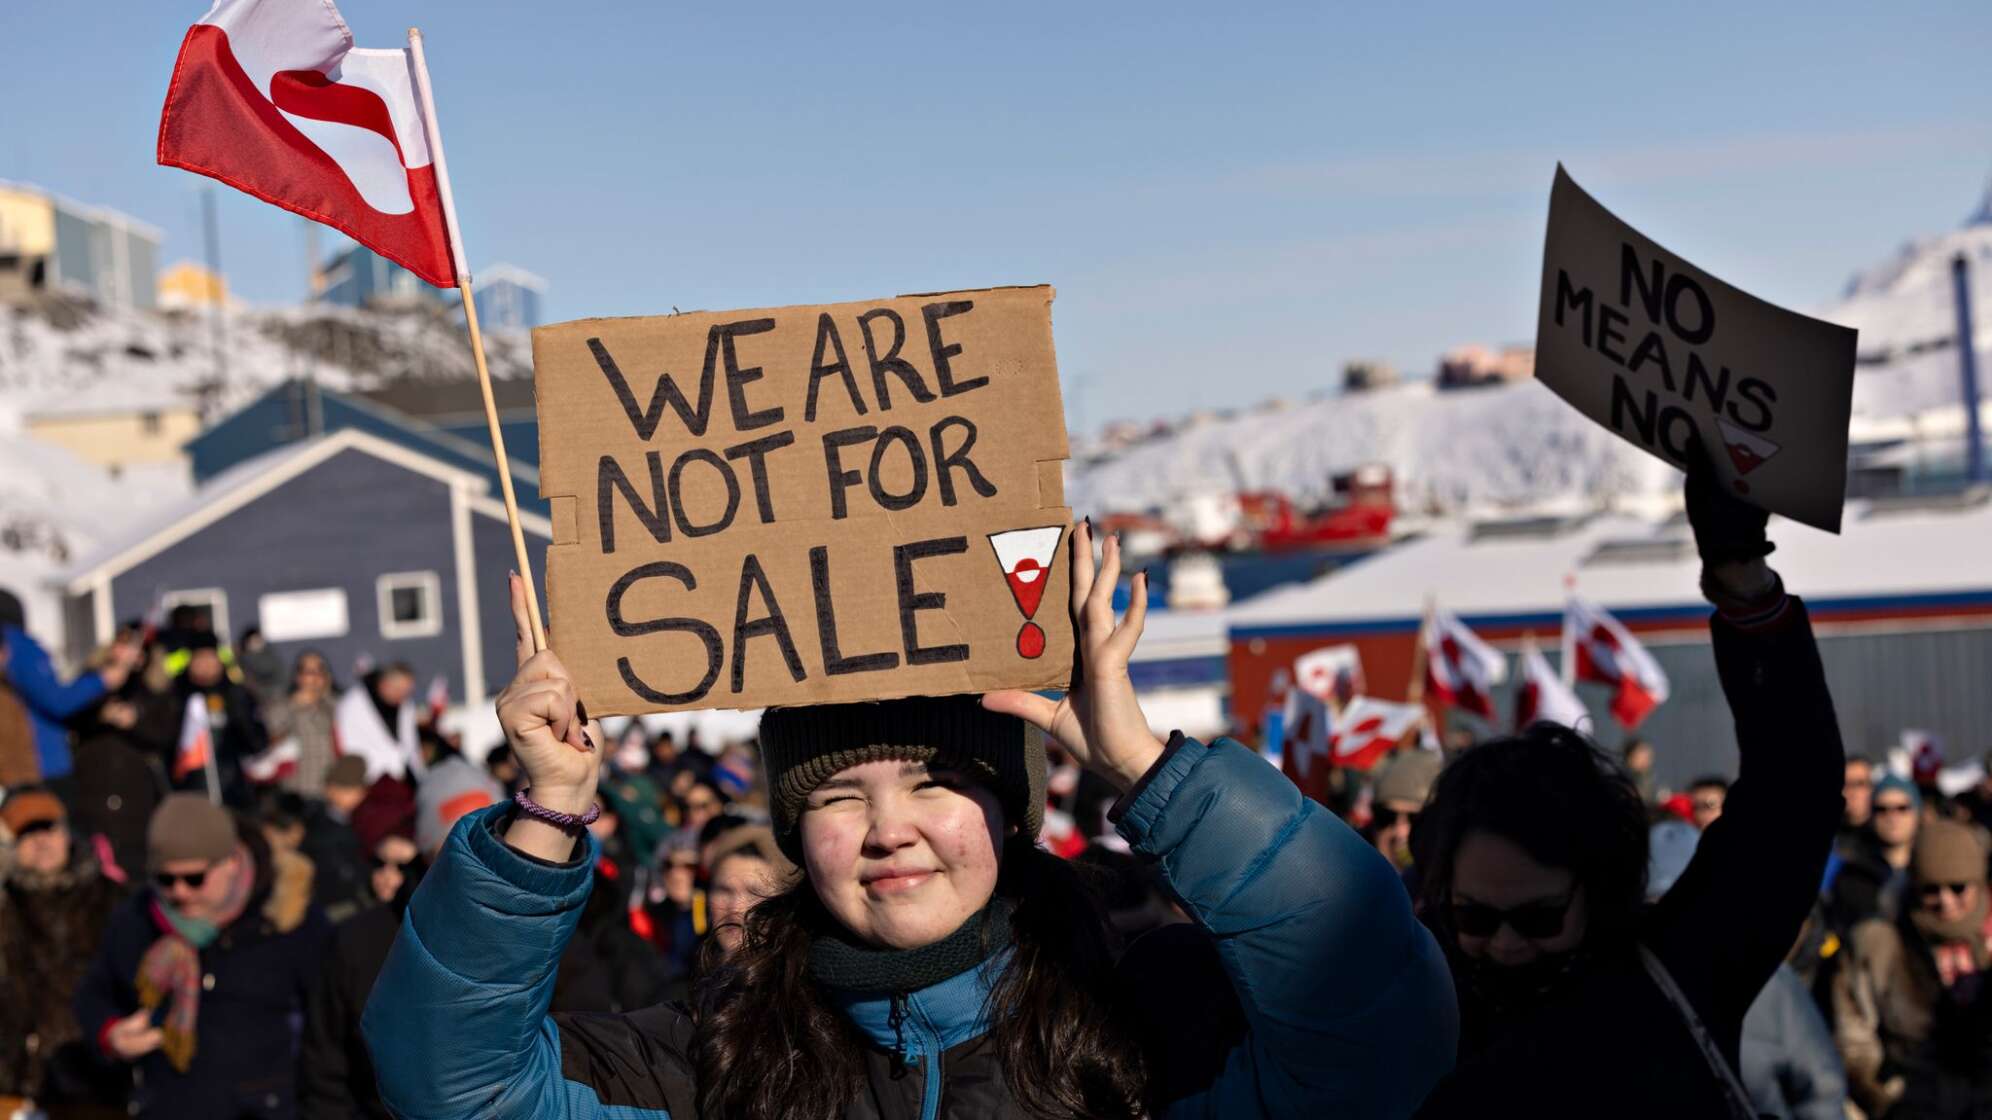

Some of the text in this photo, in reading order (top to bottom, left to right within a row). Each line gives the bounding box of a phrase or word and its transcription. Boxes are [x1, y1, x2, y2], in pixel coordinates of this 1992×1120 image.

[1554, 268, 1777, 432] MEANS
[1620, 242, 1715, 345] NO
[587, 300, 990, 441] WE ARE
[597, 416, 997, 553] NOT FOR
